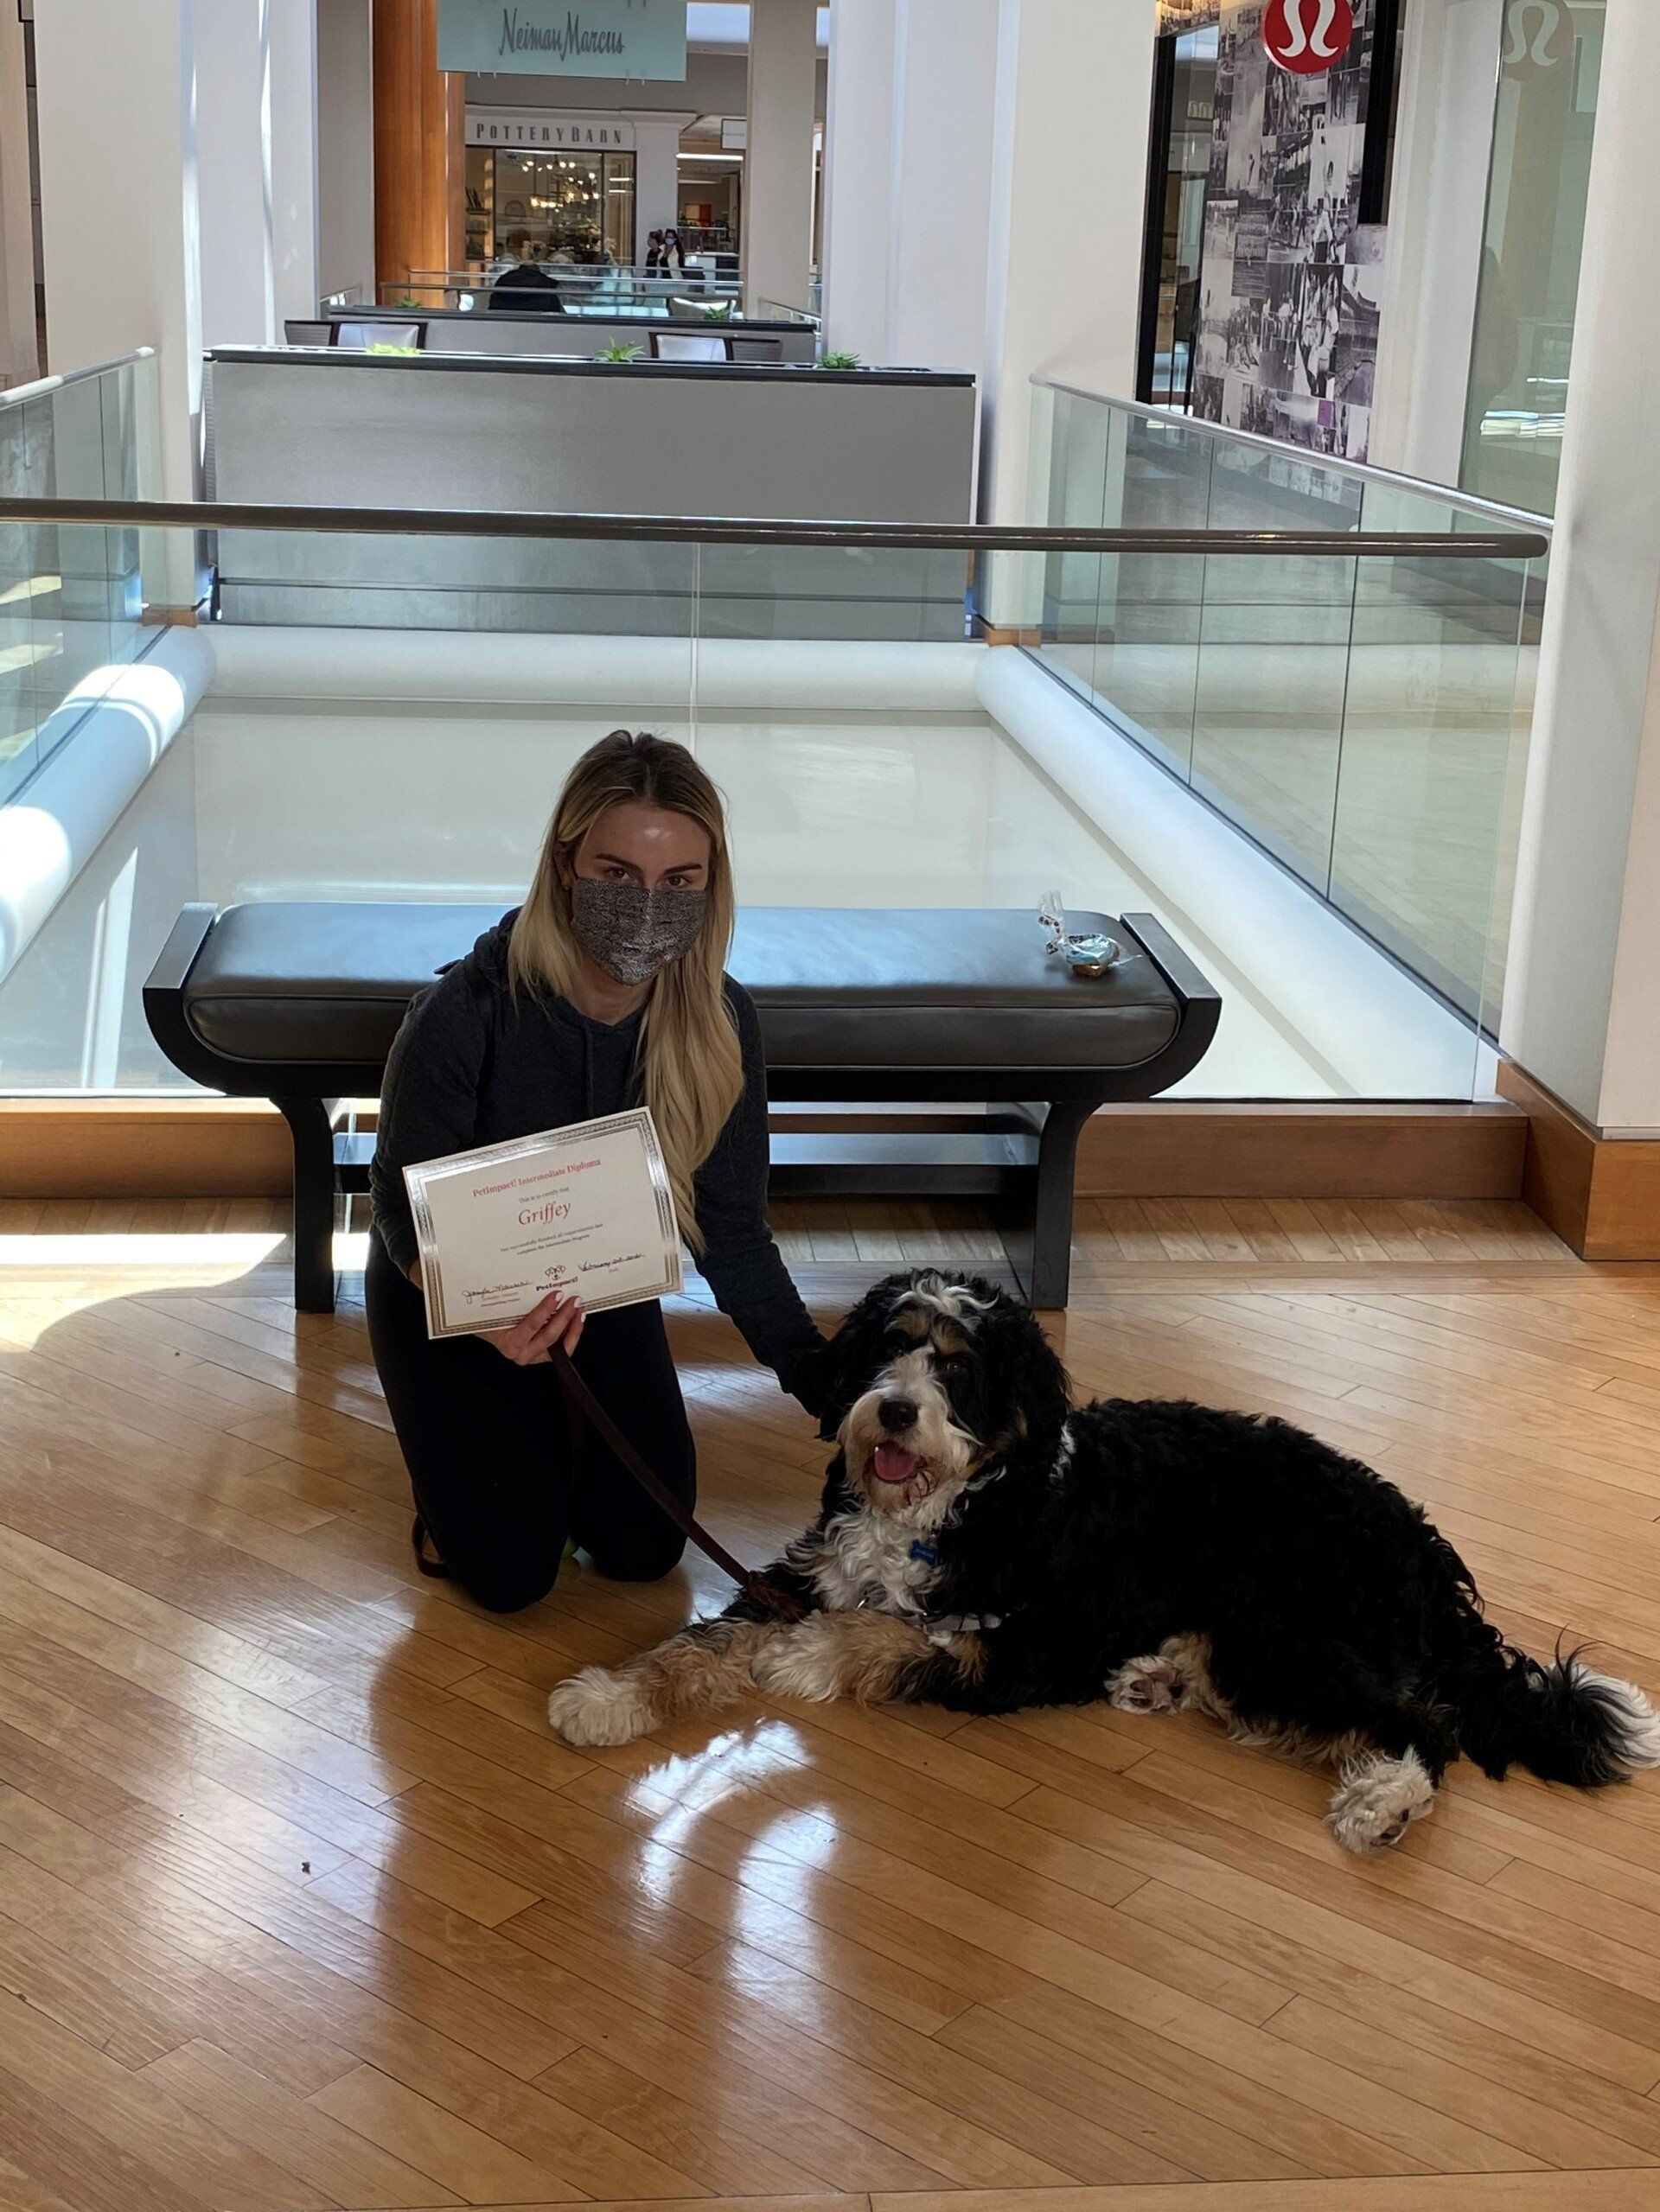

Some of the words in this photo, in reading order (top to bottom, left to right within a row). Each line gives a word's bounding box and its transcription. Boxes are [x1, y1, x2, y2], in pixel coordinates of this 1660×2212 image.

[499, 7, 562, 56] Neiman
[560, 10, 625, 61] Marcus
[476, 123, 564, 143] POTTERY
[571, 126, 622, 143] BARN
[519, 1168, 566, 1186] Intermediate
[567, 1159, 601, 1172] Diploma
[518, 1201, 571, 1226] Griffey
